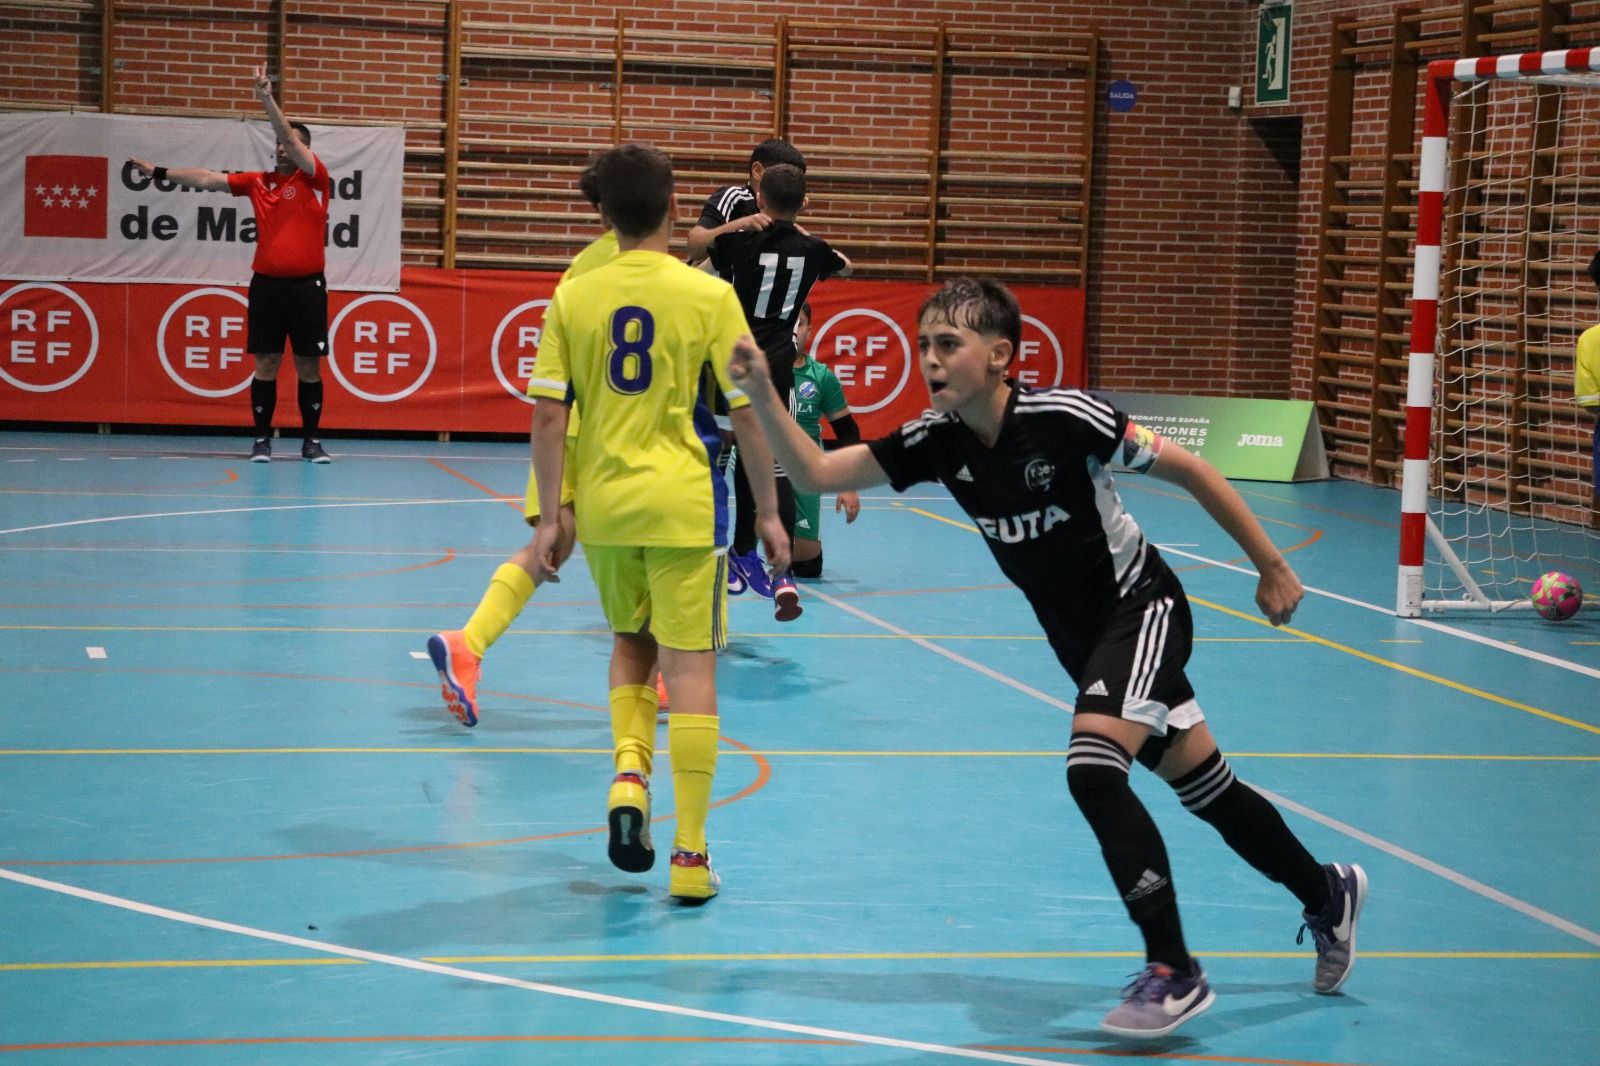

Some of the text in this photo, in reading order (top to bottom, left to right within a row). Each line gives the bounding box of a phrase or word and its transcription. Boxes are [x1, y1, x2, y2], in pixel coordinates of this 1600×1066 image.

[120, 206, 178, 241] de
[754, 253, 805, 320] 11
[607, 305, 655, 395] 8
[1178, 417, 1210, 425] ESPAÑA
[976, 504, 1071, 544] EUTA
